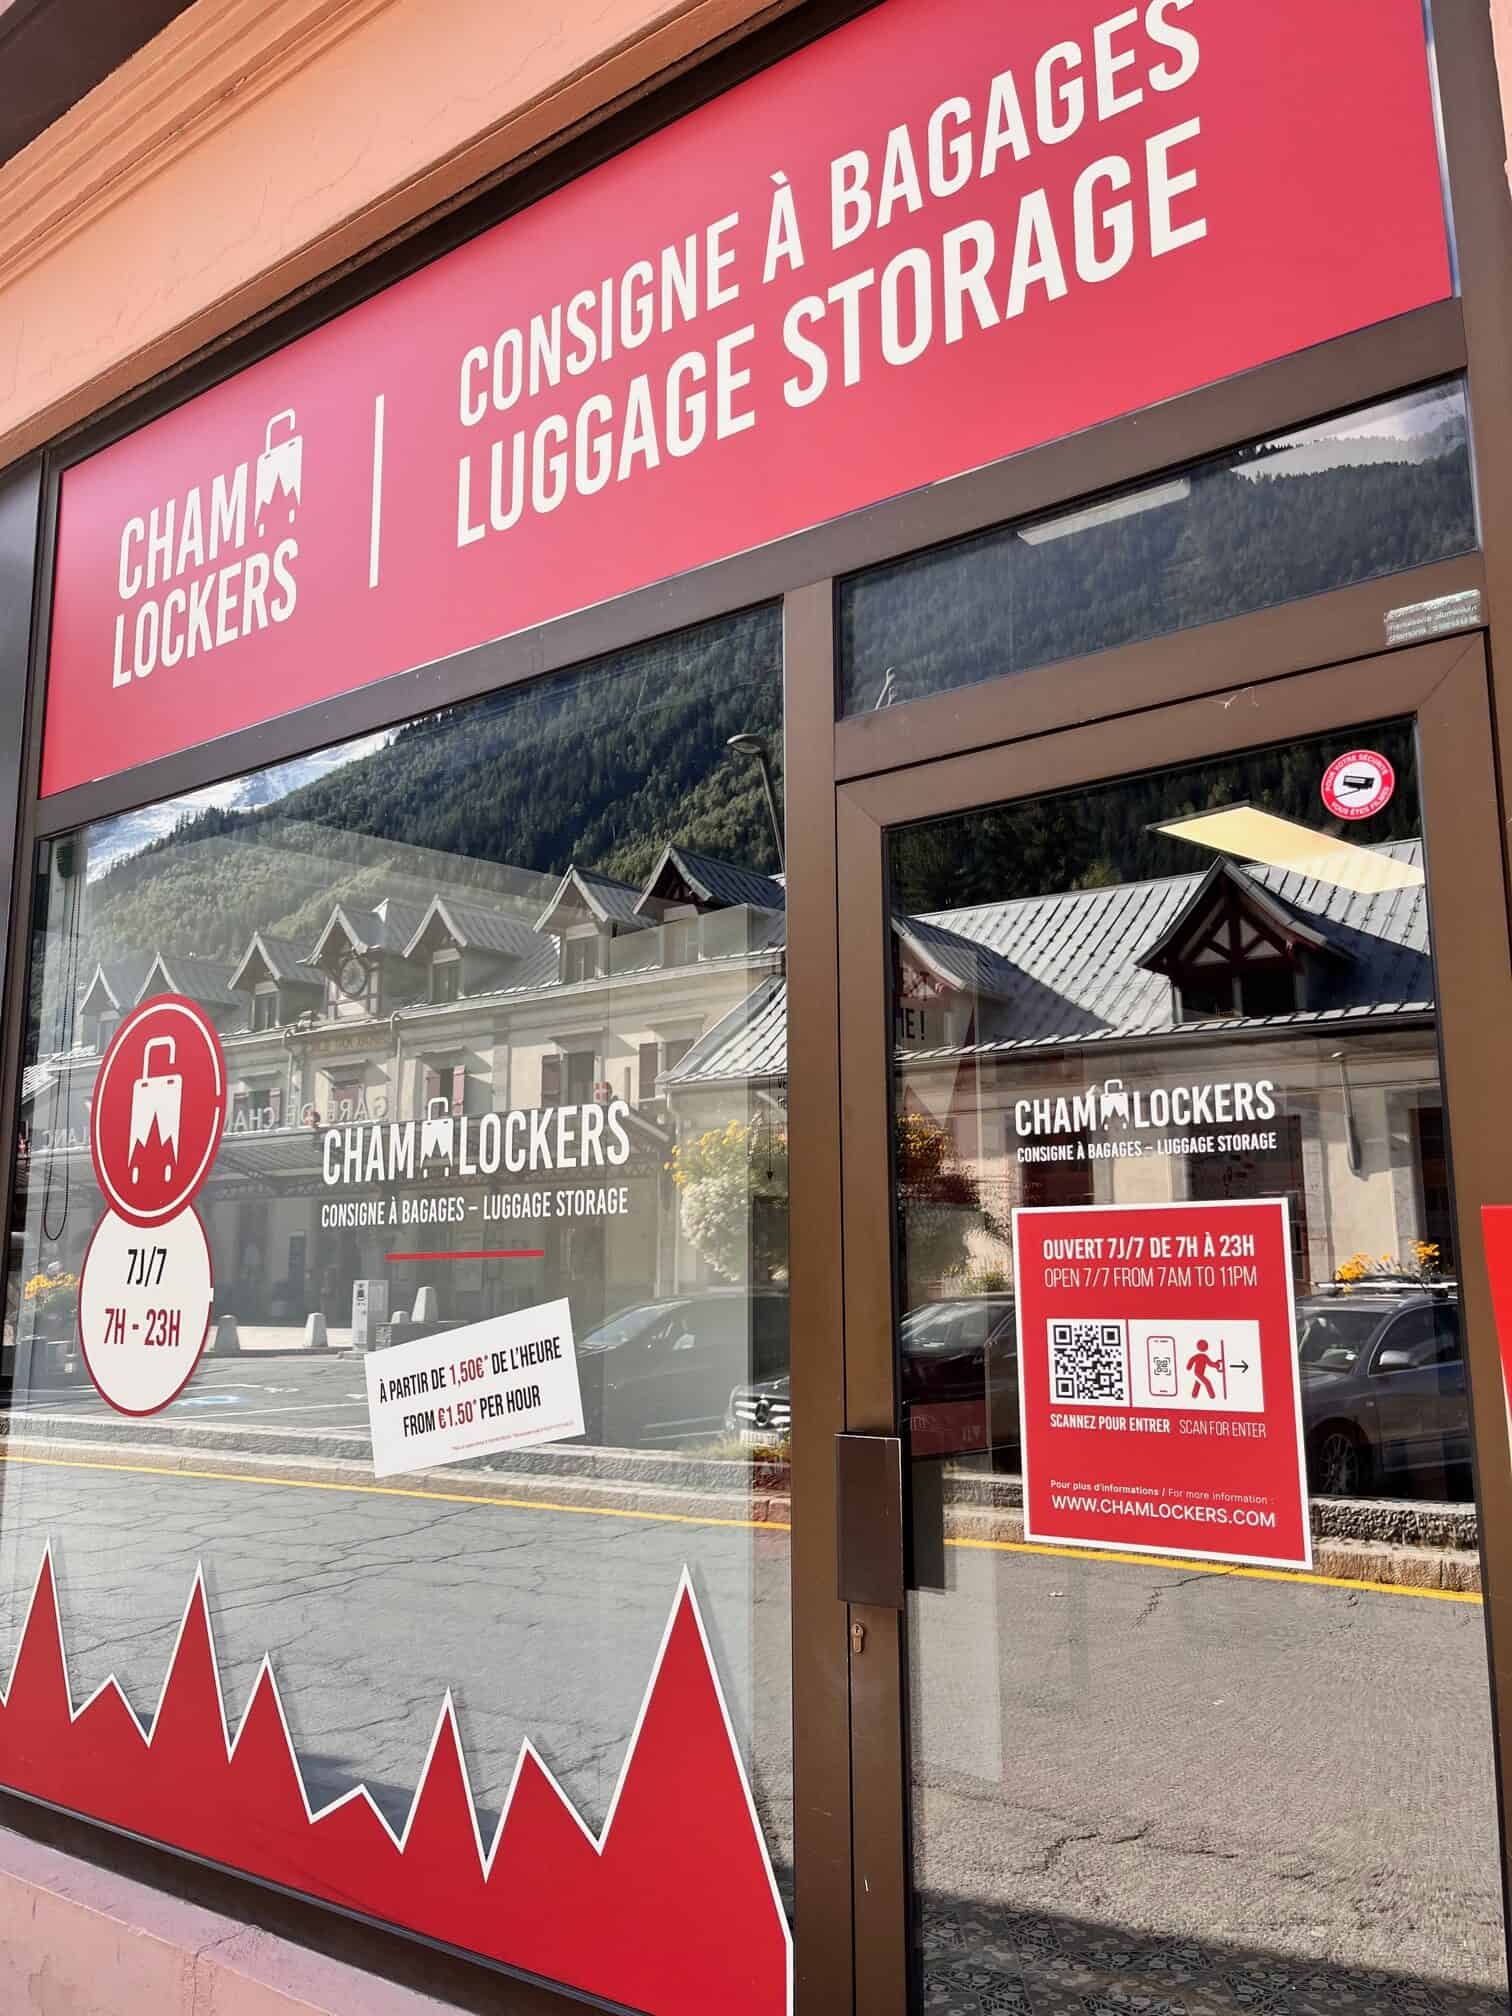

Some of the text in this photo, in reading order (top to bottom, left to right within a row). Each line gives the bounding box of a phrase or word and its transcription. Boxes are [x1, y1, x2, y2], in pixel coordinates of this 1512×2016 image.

[459, 0, 1201, 428] CONSIGNE À BAGAGES
[455, 117, 1208, 547] LUGGAGE STORAGE
[119, 462, 248, 600] CHAM
[112, 538, 299, 688] LOCKERS
[1015, 1080, 1276, 1136] CHAM LOCKERS
[322, 1100, 631, 1185] CHAM LOCKERS
[1017, 1144, 1074, 1163] CONSIGNE
[1077, 1141, 1085, 1160] À
[1088, 1141, 1142, 1160] BAGAGES
[1157, 1136, 1214, 1155] LUGGAGE
[1218, 1132, 1277, 1153] STORAGE
[321, 1201, 385, 1228] CONSIGNE
[388, 1196, 398, 1225] À
[402, 1197, 465, 1225] BAGAGES
[483, 1191, 551, 1221] LUGGAGE
[556, 1187, 629, 1217] STORAGE
[1043, 1231, 1255, 1260] OUVERT 7J/7 DE 7H À 23H
[127, 1246, 167, 1287] 7J/7
[1044, 1265, 1257, 1288] OPEN 7/7 FROM 7AM TO 11PM
[104, 1308, 126, 1344] 7H
[144, 1308, 181, 1346] 23H
[380, 1378, 387, 1403] À
[389, 1371, 429, 1401] PARTIR
[431, 1367, 447, 1390] DE
[491, 1351, 508, 1375] DE
[510, 1336, 562, 1370] L'HEURE
[403, 1410, 436, 1437] FROM
[480, 1394, 504, 1419] PER
[506, 1385, 541, 1413] HOUR
[1050, 1413, 1267, 1438] SCANNEZ POUR ENTRER SCAN FOR ENTER
[1050, 1480, 1071, 1489] Pour
[1073, 1481, 1091, 1491] plus
[1094, 1482, 1159, 1496] d'informations
[1168, 1488, 1184, 1498] For
[1186, 1491, 1209, 1500] more
[1212, 1489, 1268, 1504] information
[1052, 1495, 1276, 1527] WWW.CHAMLOCKERS.COM
